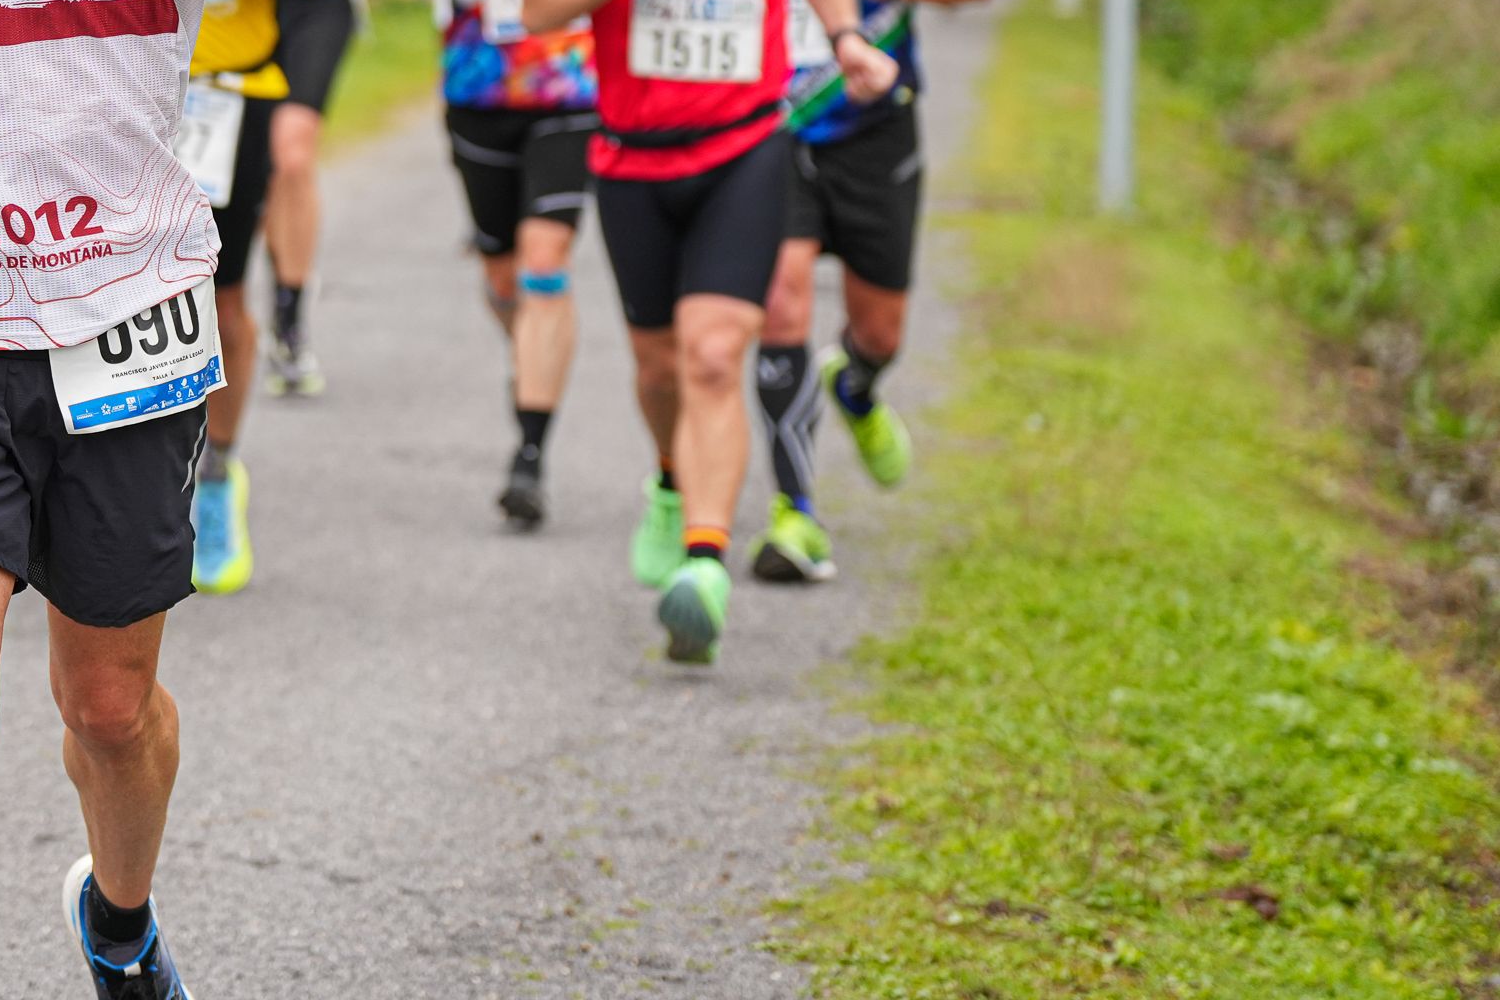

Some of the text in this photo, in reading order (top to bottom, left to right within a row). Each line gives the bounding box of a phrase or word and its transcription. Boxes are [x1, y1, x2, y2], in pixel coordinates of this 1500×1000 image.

[654, 29, 739, 71] 1515
[7, 255, 28, 268] DE
[32, 241, 113, 268] MONTAÑA
[111, 366, 148, 379] FRANCISCO
[149, 361, 168, 371] JAVIER
[152, 373, 169, 381] TALLA
